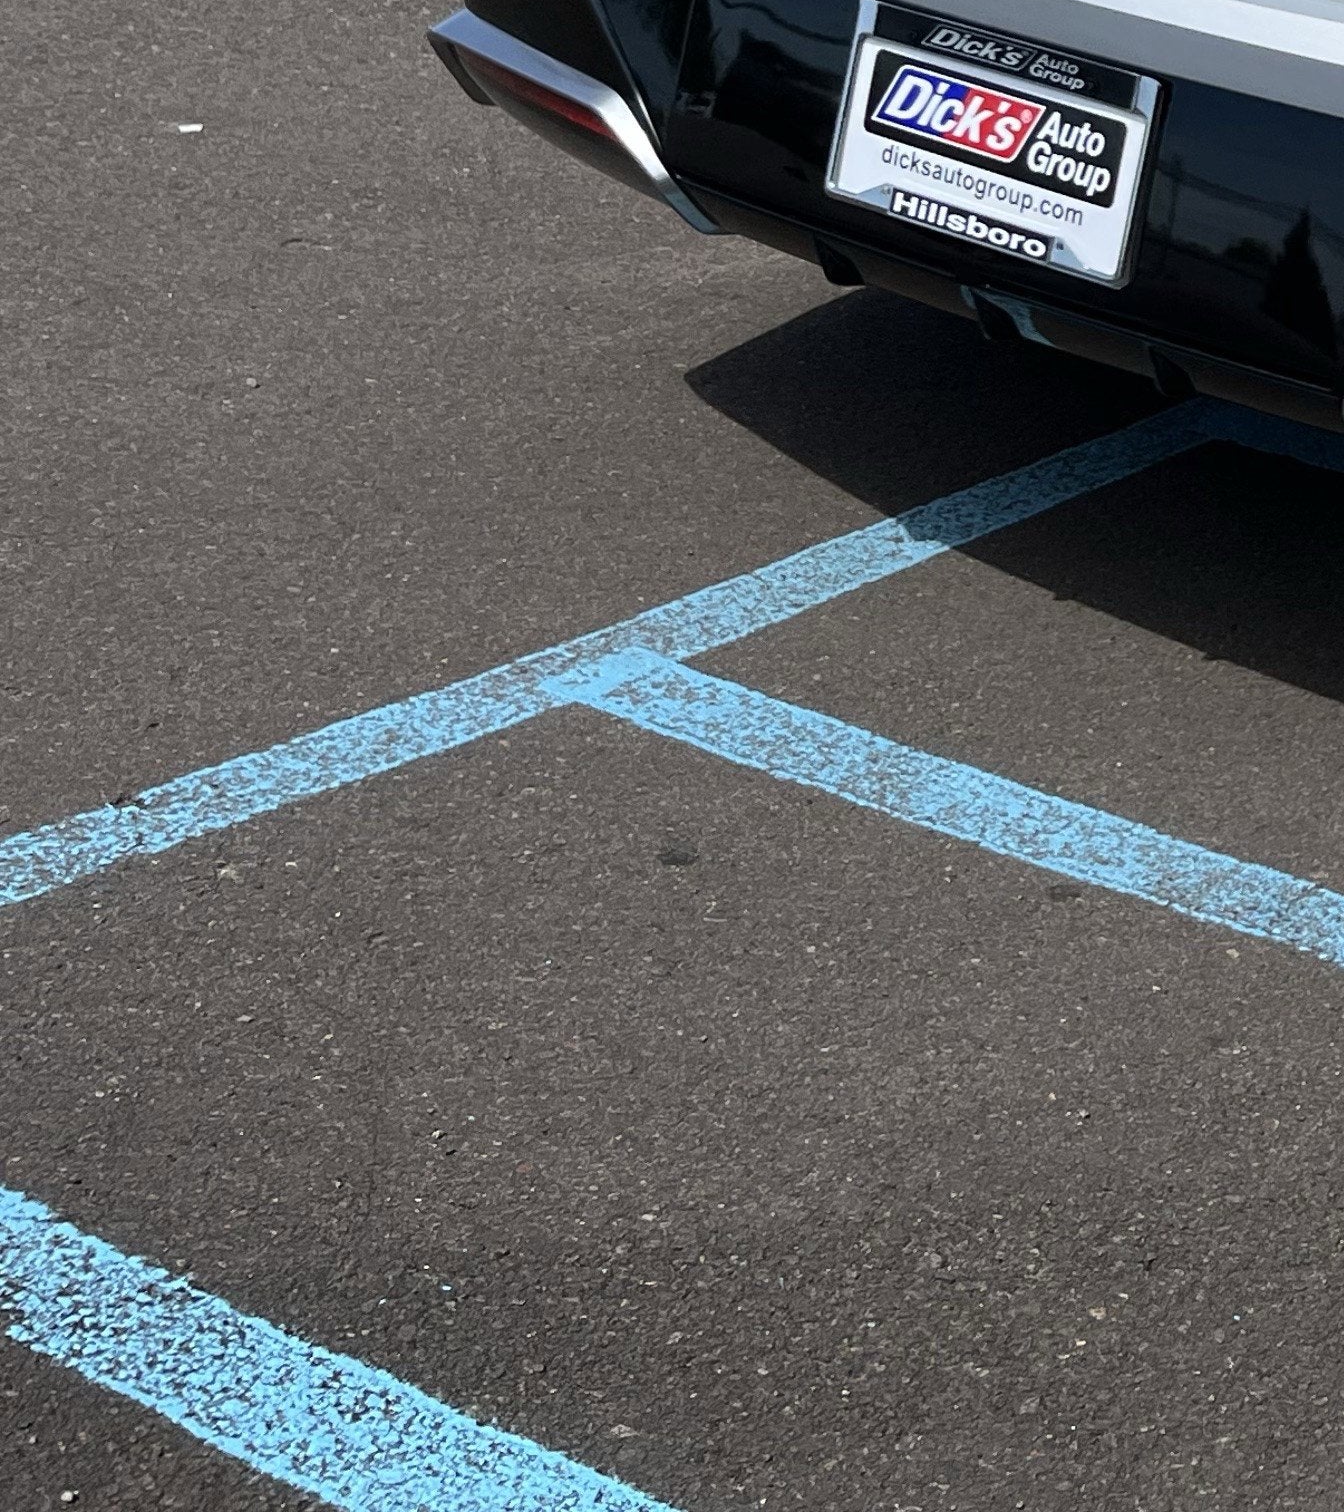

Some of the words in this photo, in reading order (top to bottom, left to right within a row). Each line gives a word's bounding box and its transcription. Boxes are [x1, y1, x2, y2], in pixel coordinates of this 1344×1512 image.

[930, 27, 1024, 67] Dick's
[1036, 53, 1081, 76] Auto
[1028, 63, 1086, 91] Group
[884, 74, 1024, 151] Dick's
[1036, 111, 1106, 157] Auto
[881, 144, 1084, 226] dicksautogroup.com
[1026, 143, 1112, 197] Group
[892, 191, 1048, 258] Hillsboro
